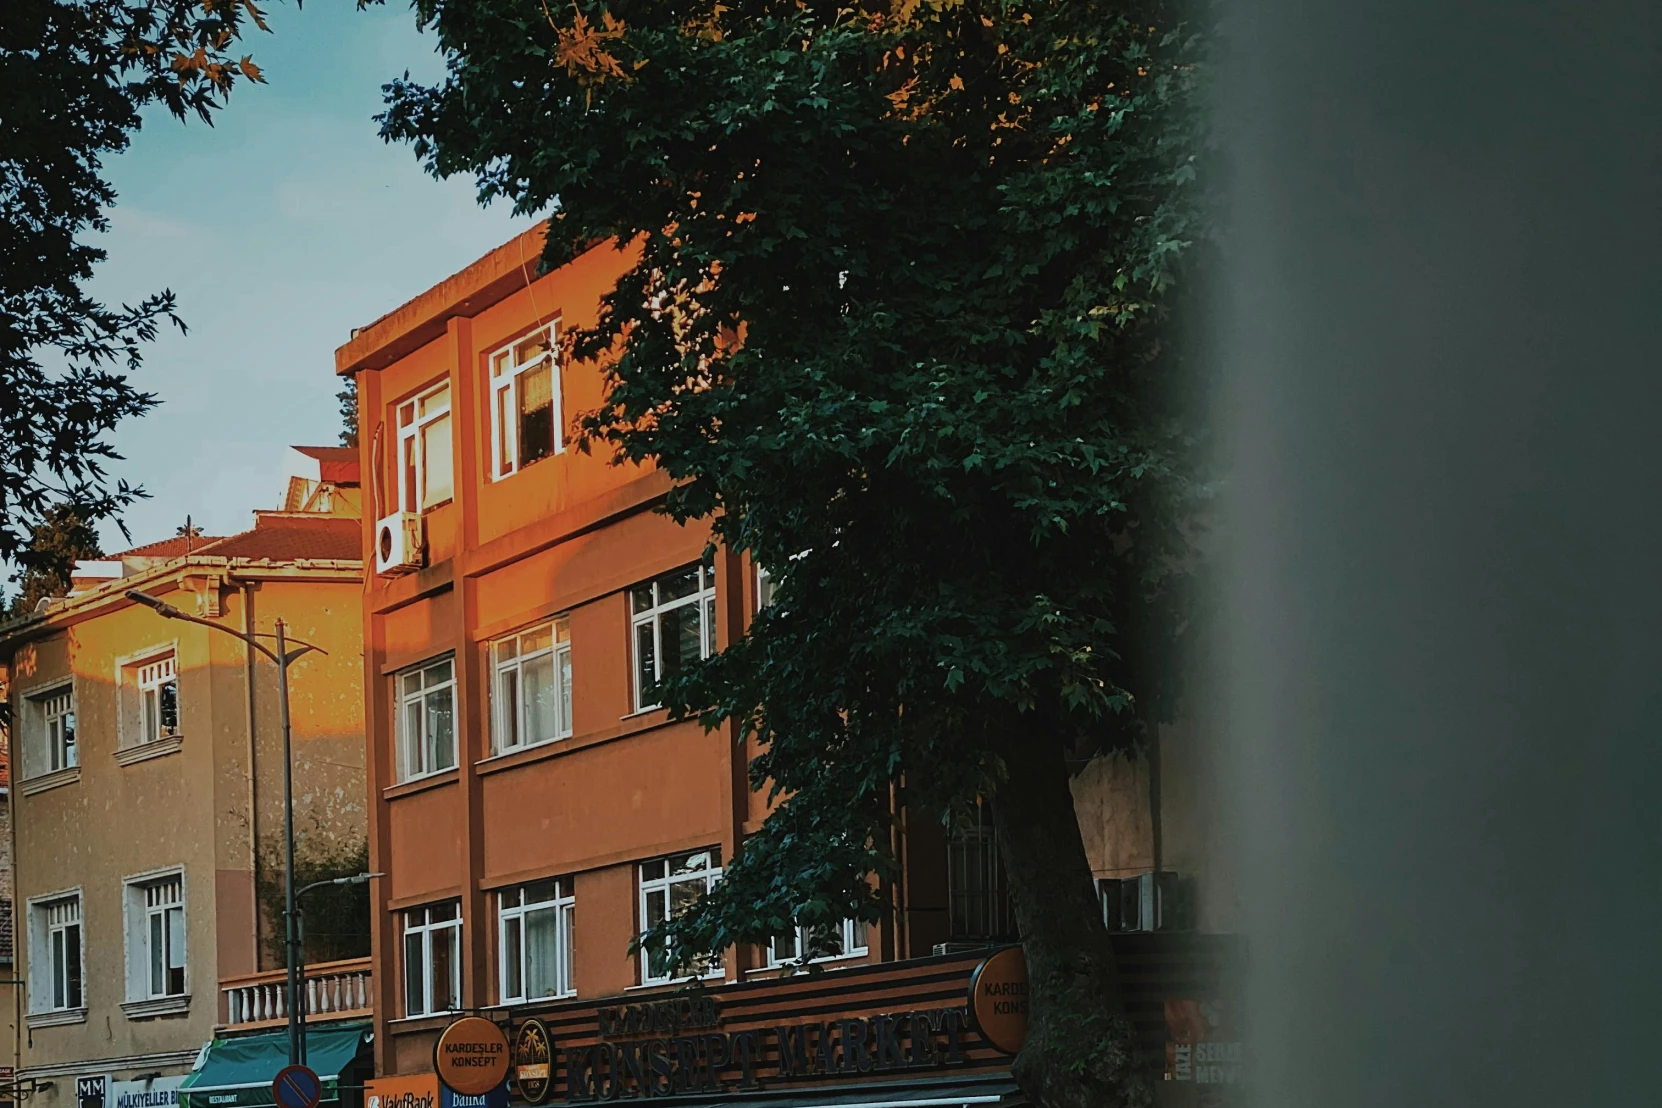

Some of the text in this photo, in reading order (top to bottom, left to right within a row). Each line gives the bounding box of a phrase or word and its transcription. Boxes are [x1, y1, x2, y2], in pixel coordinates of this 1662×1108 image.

[985, 982, 1028, 996] KARDE
[993, 1001, 1028, 1014] KONS
[445, 1043, 503, 1054] KARDEŞLER
[562, 1006, 970, 1102] KONSEPT MARKET
[452, 1057, 497, 1067] KONSEPT
[79, 1079, 104, 1096] MM
[117, 1088, 169, 1108] MÜLKİYELİLER
[208, 1094, 238, 1104] RESTAURANT
